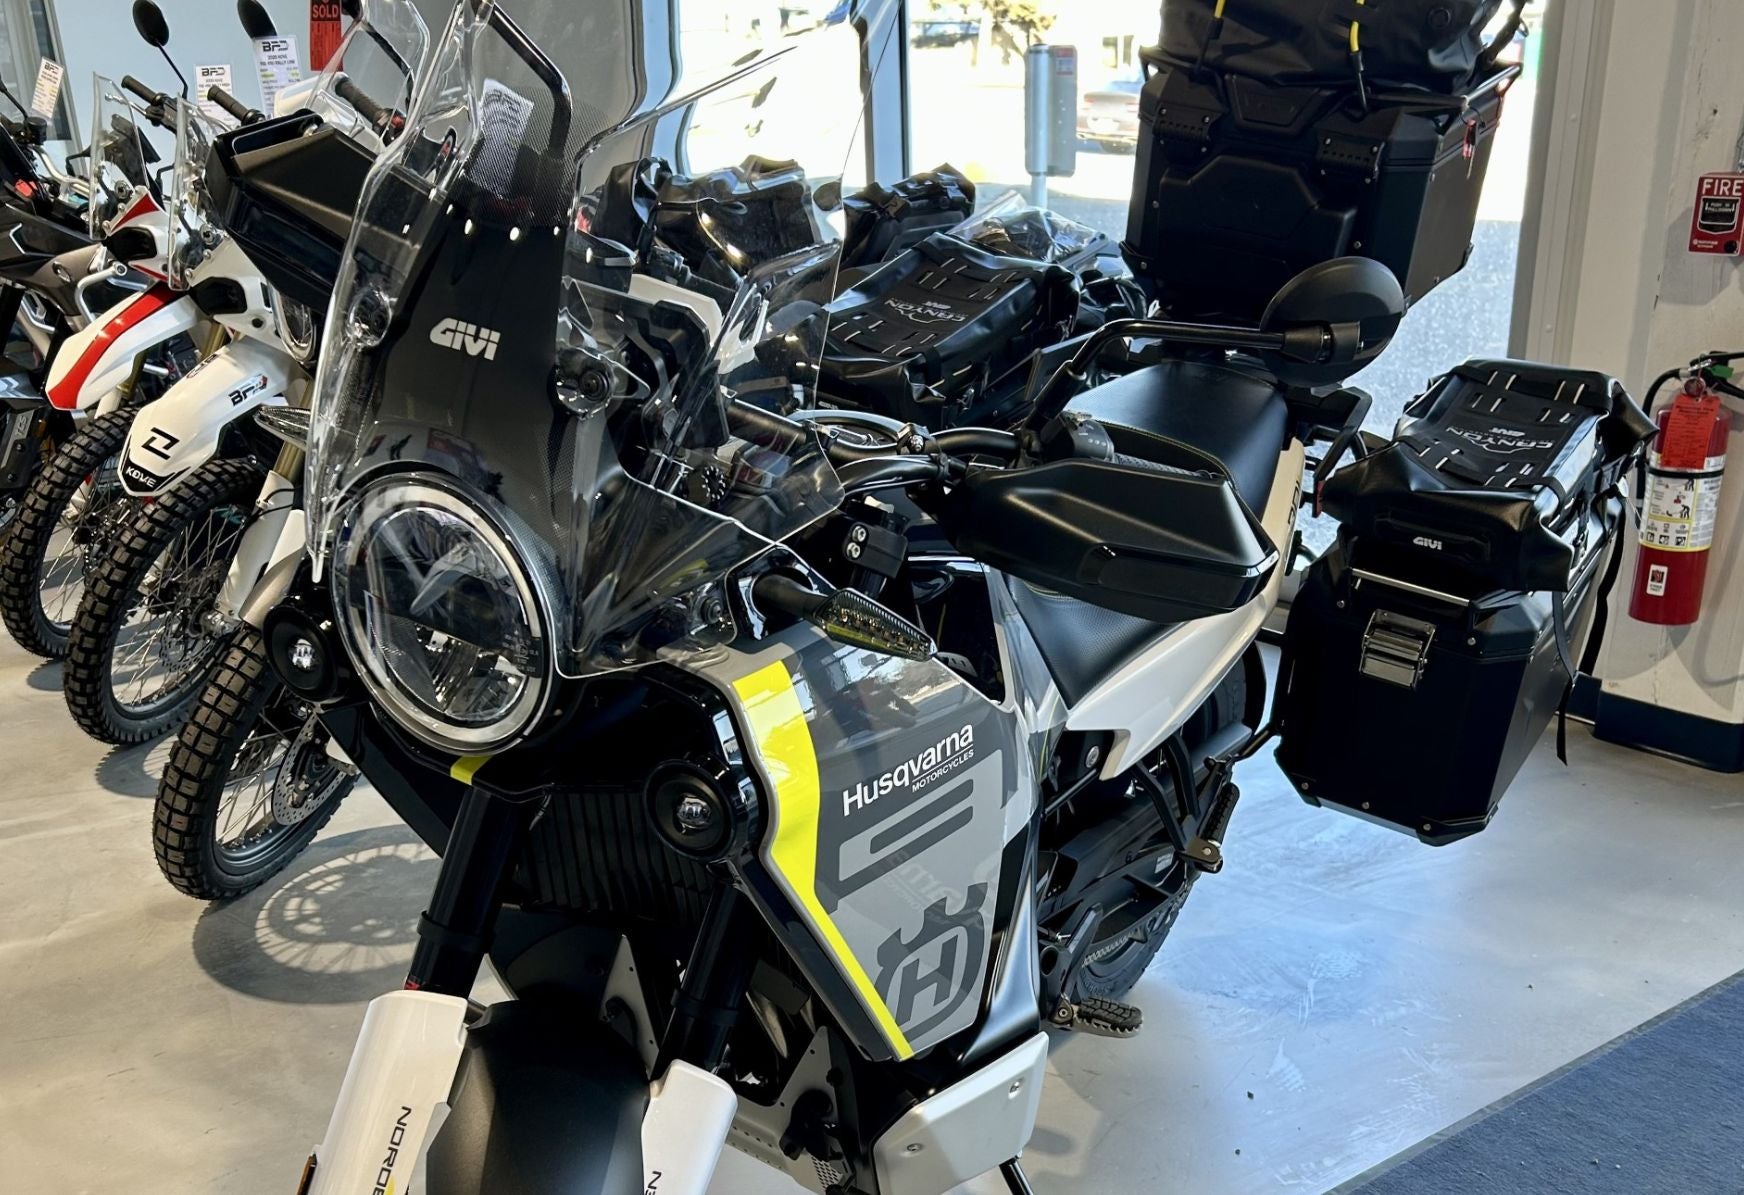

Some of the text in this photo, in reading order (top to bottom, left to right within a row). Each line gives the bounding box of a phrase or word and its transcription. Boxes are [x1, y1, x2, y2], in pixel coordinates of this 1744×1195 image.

[312, 4, 339, 18] SOLD
[1702, 178, 1744, 196] FIRE
[429, 317, 501, 361] GIVI
[1446, 427, 1553, 449] CANYON
[125, 466, 157, 488] KOVE
[1413, 536, 1442, 550] GIVI
[842, 724, 974, 817] Husqvarna
[912, 749, 974, 793] MOTORCYCLES
